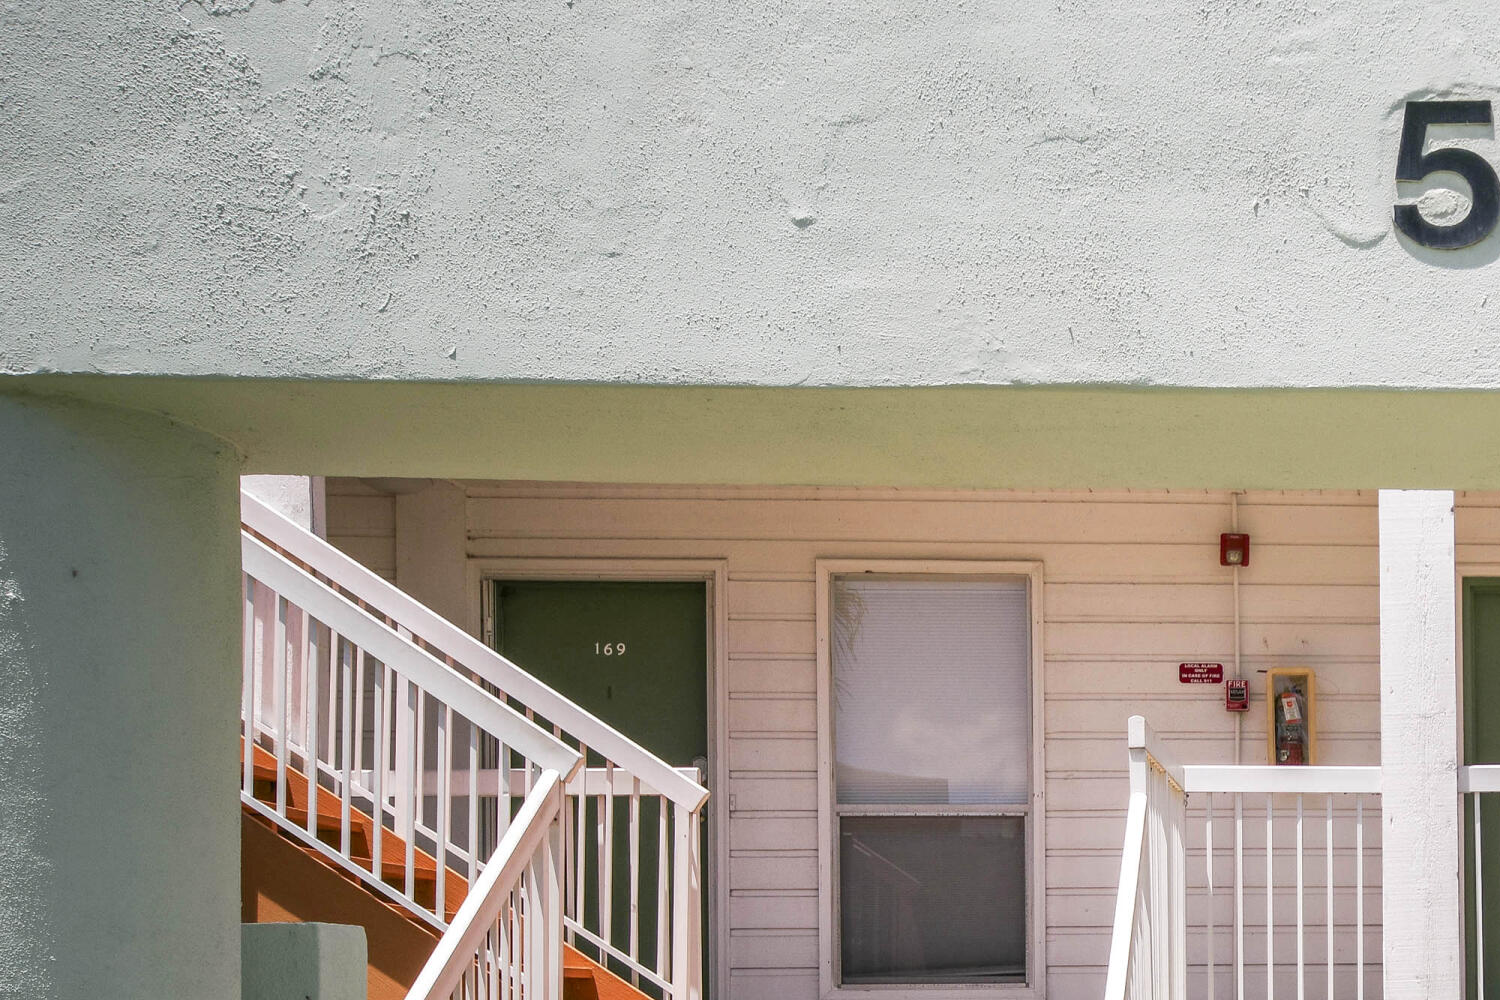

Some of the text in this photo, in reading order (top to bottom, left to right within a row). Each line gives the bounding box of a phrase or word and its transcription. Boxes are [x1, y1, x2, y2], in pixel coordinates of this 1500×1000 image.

[1394, 100, 1500, 251] 5
[595, 642, 625, 656] 169
[1228, 680, 1246, 688] FIRE
